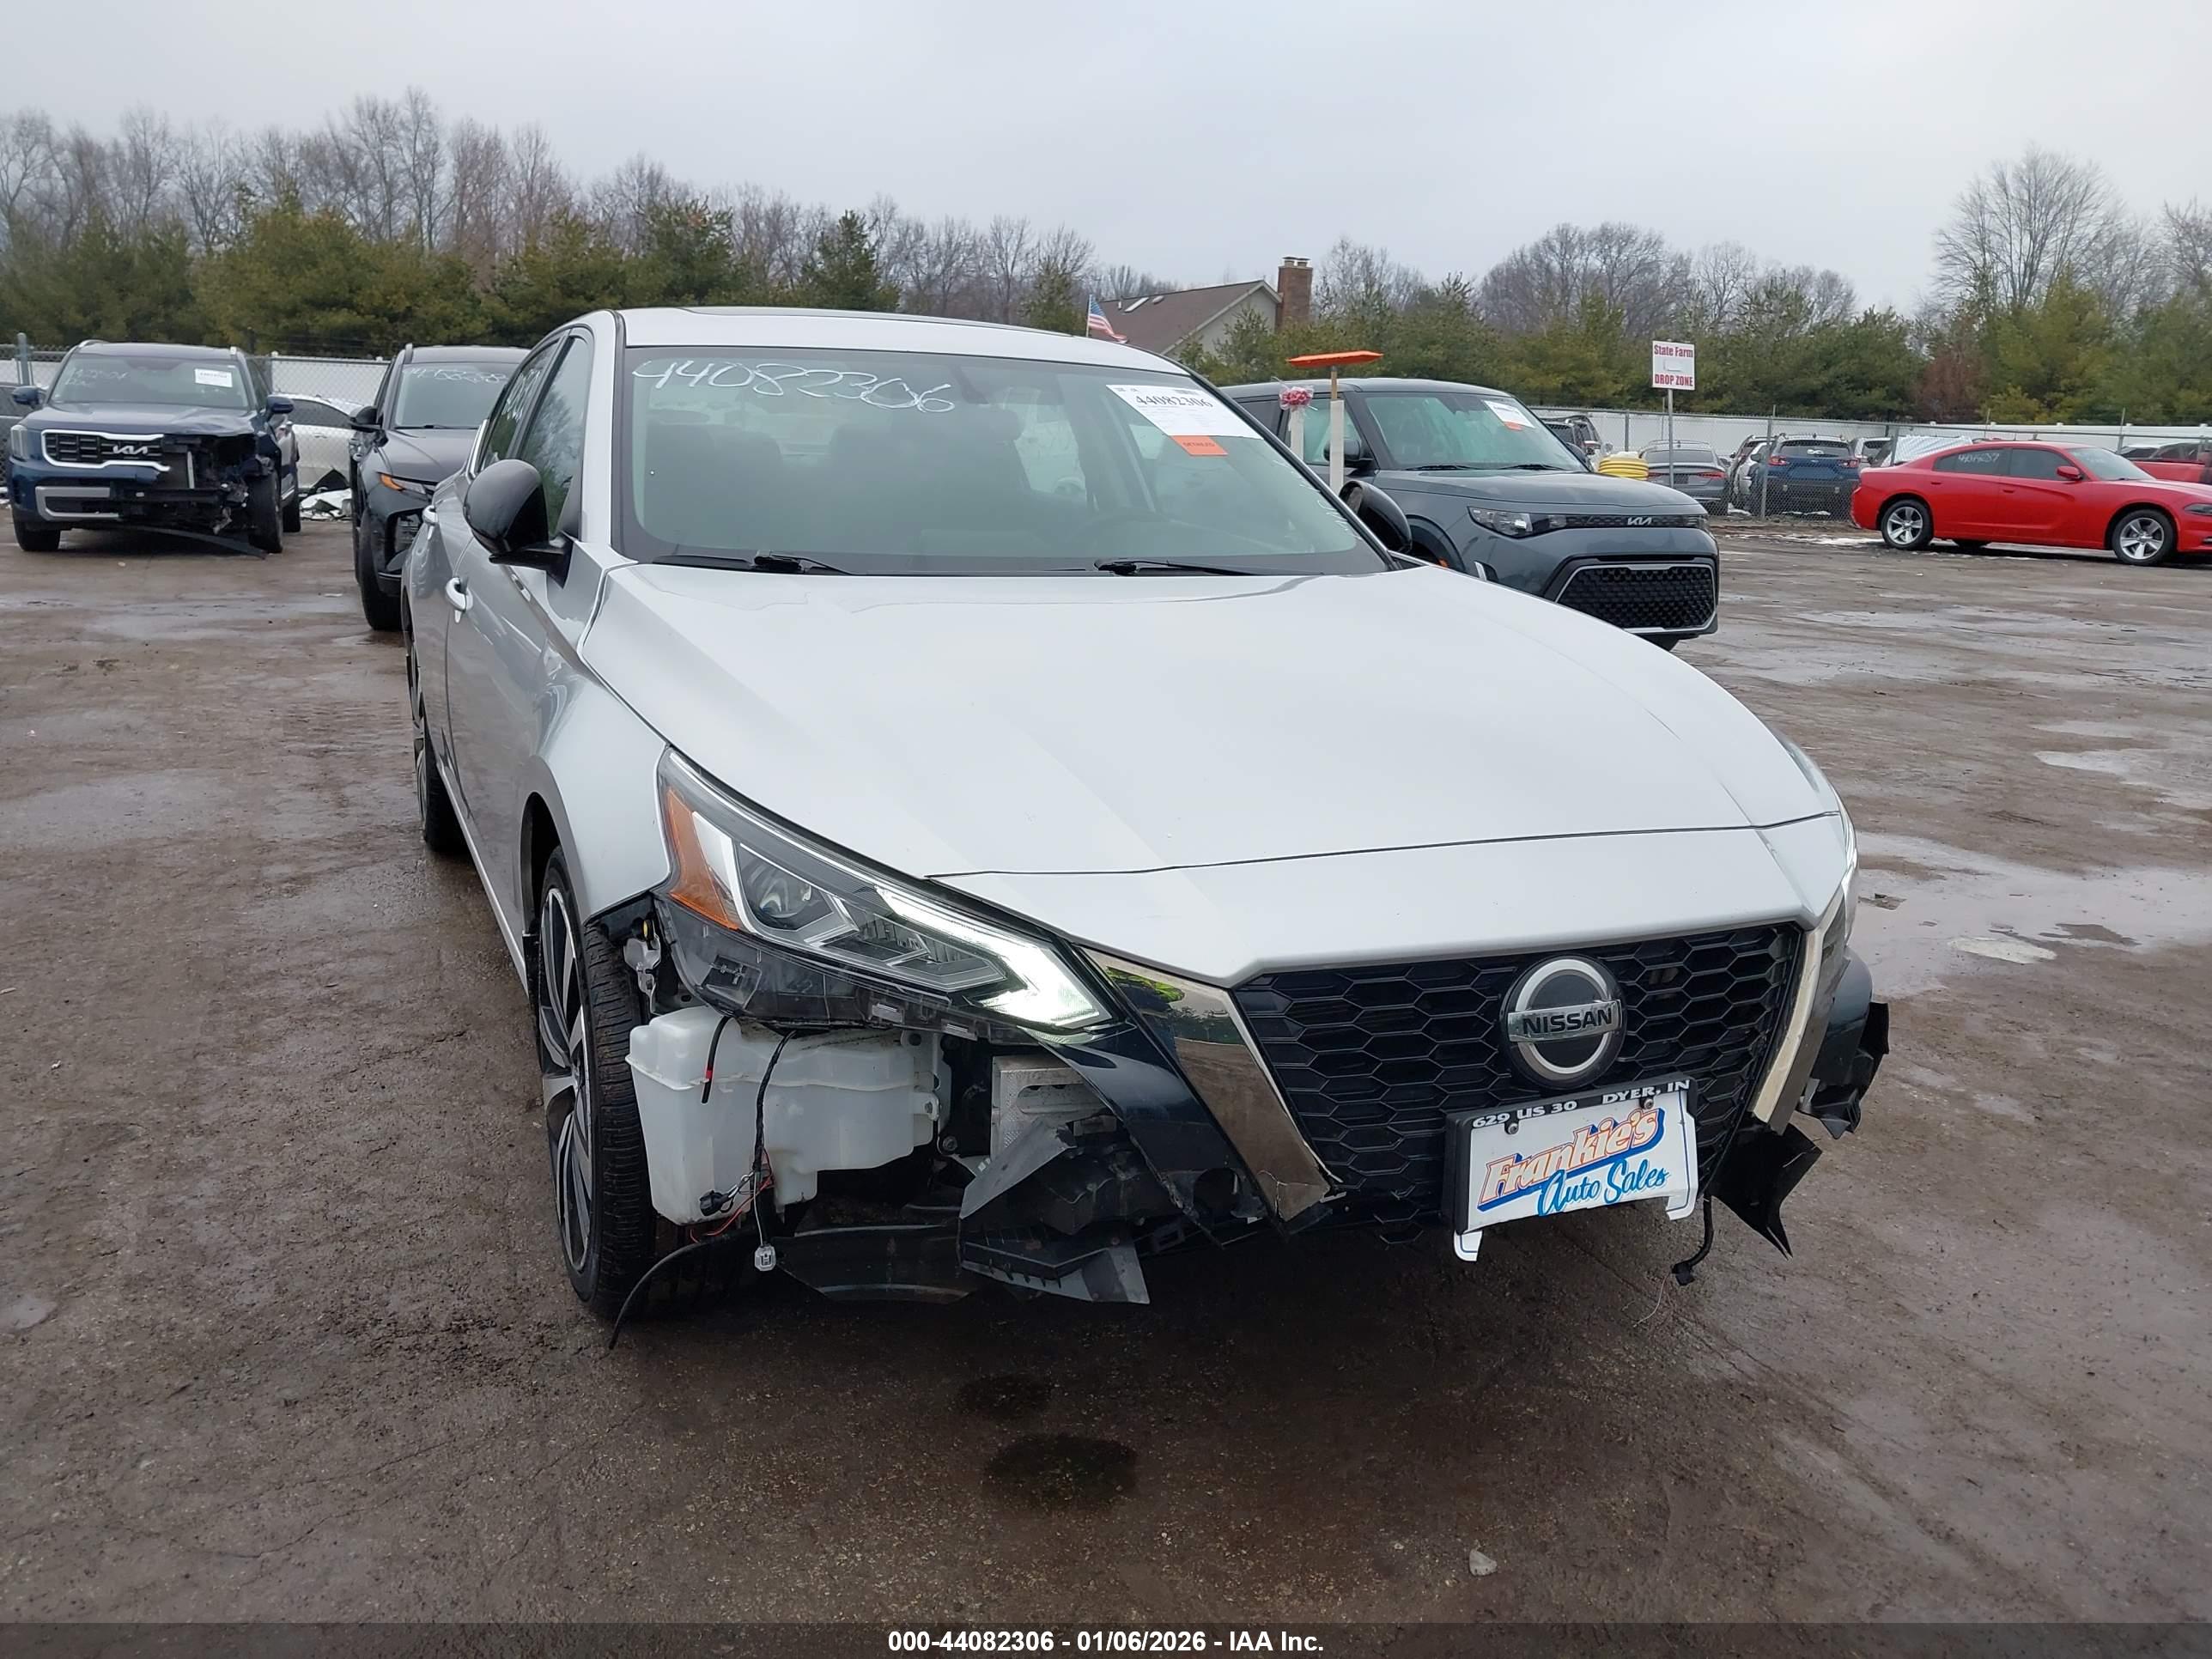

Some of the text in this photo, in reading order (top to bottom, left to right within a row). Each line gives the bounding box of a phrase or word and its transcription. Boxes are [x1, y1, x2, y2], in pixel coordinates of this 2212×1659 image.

[1654, 344, 1693, 358] State Farm
[632, 360, 955, 412] 44082306
[1655, 374, 1693, 386] DROP ZONE
[1136, 395, 1213, 408] 44082306
[1627, 517, 1652, 526] KIA
[1522, 1007, 1612, 1035] NISSAN
[1472, 1079, 1691, 1128] 629 US 30 DYER, IN
[1478, 1107, 1664, 1210] Frankie's
[1537, 1159, 1670, 1216] Auto Sales
